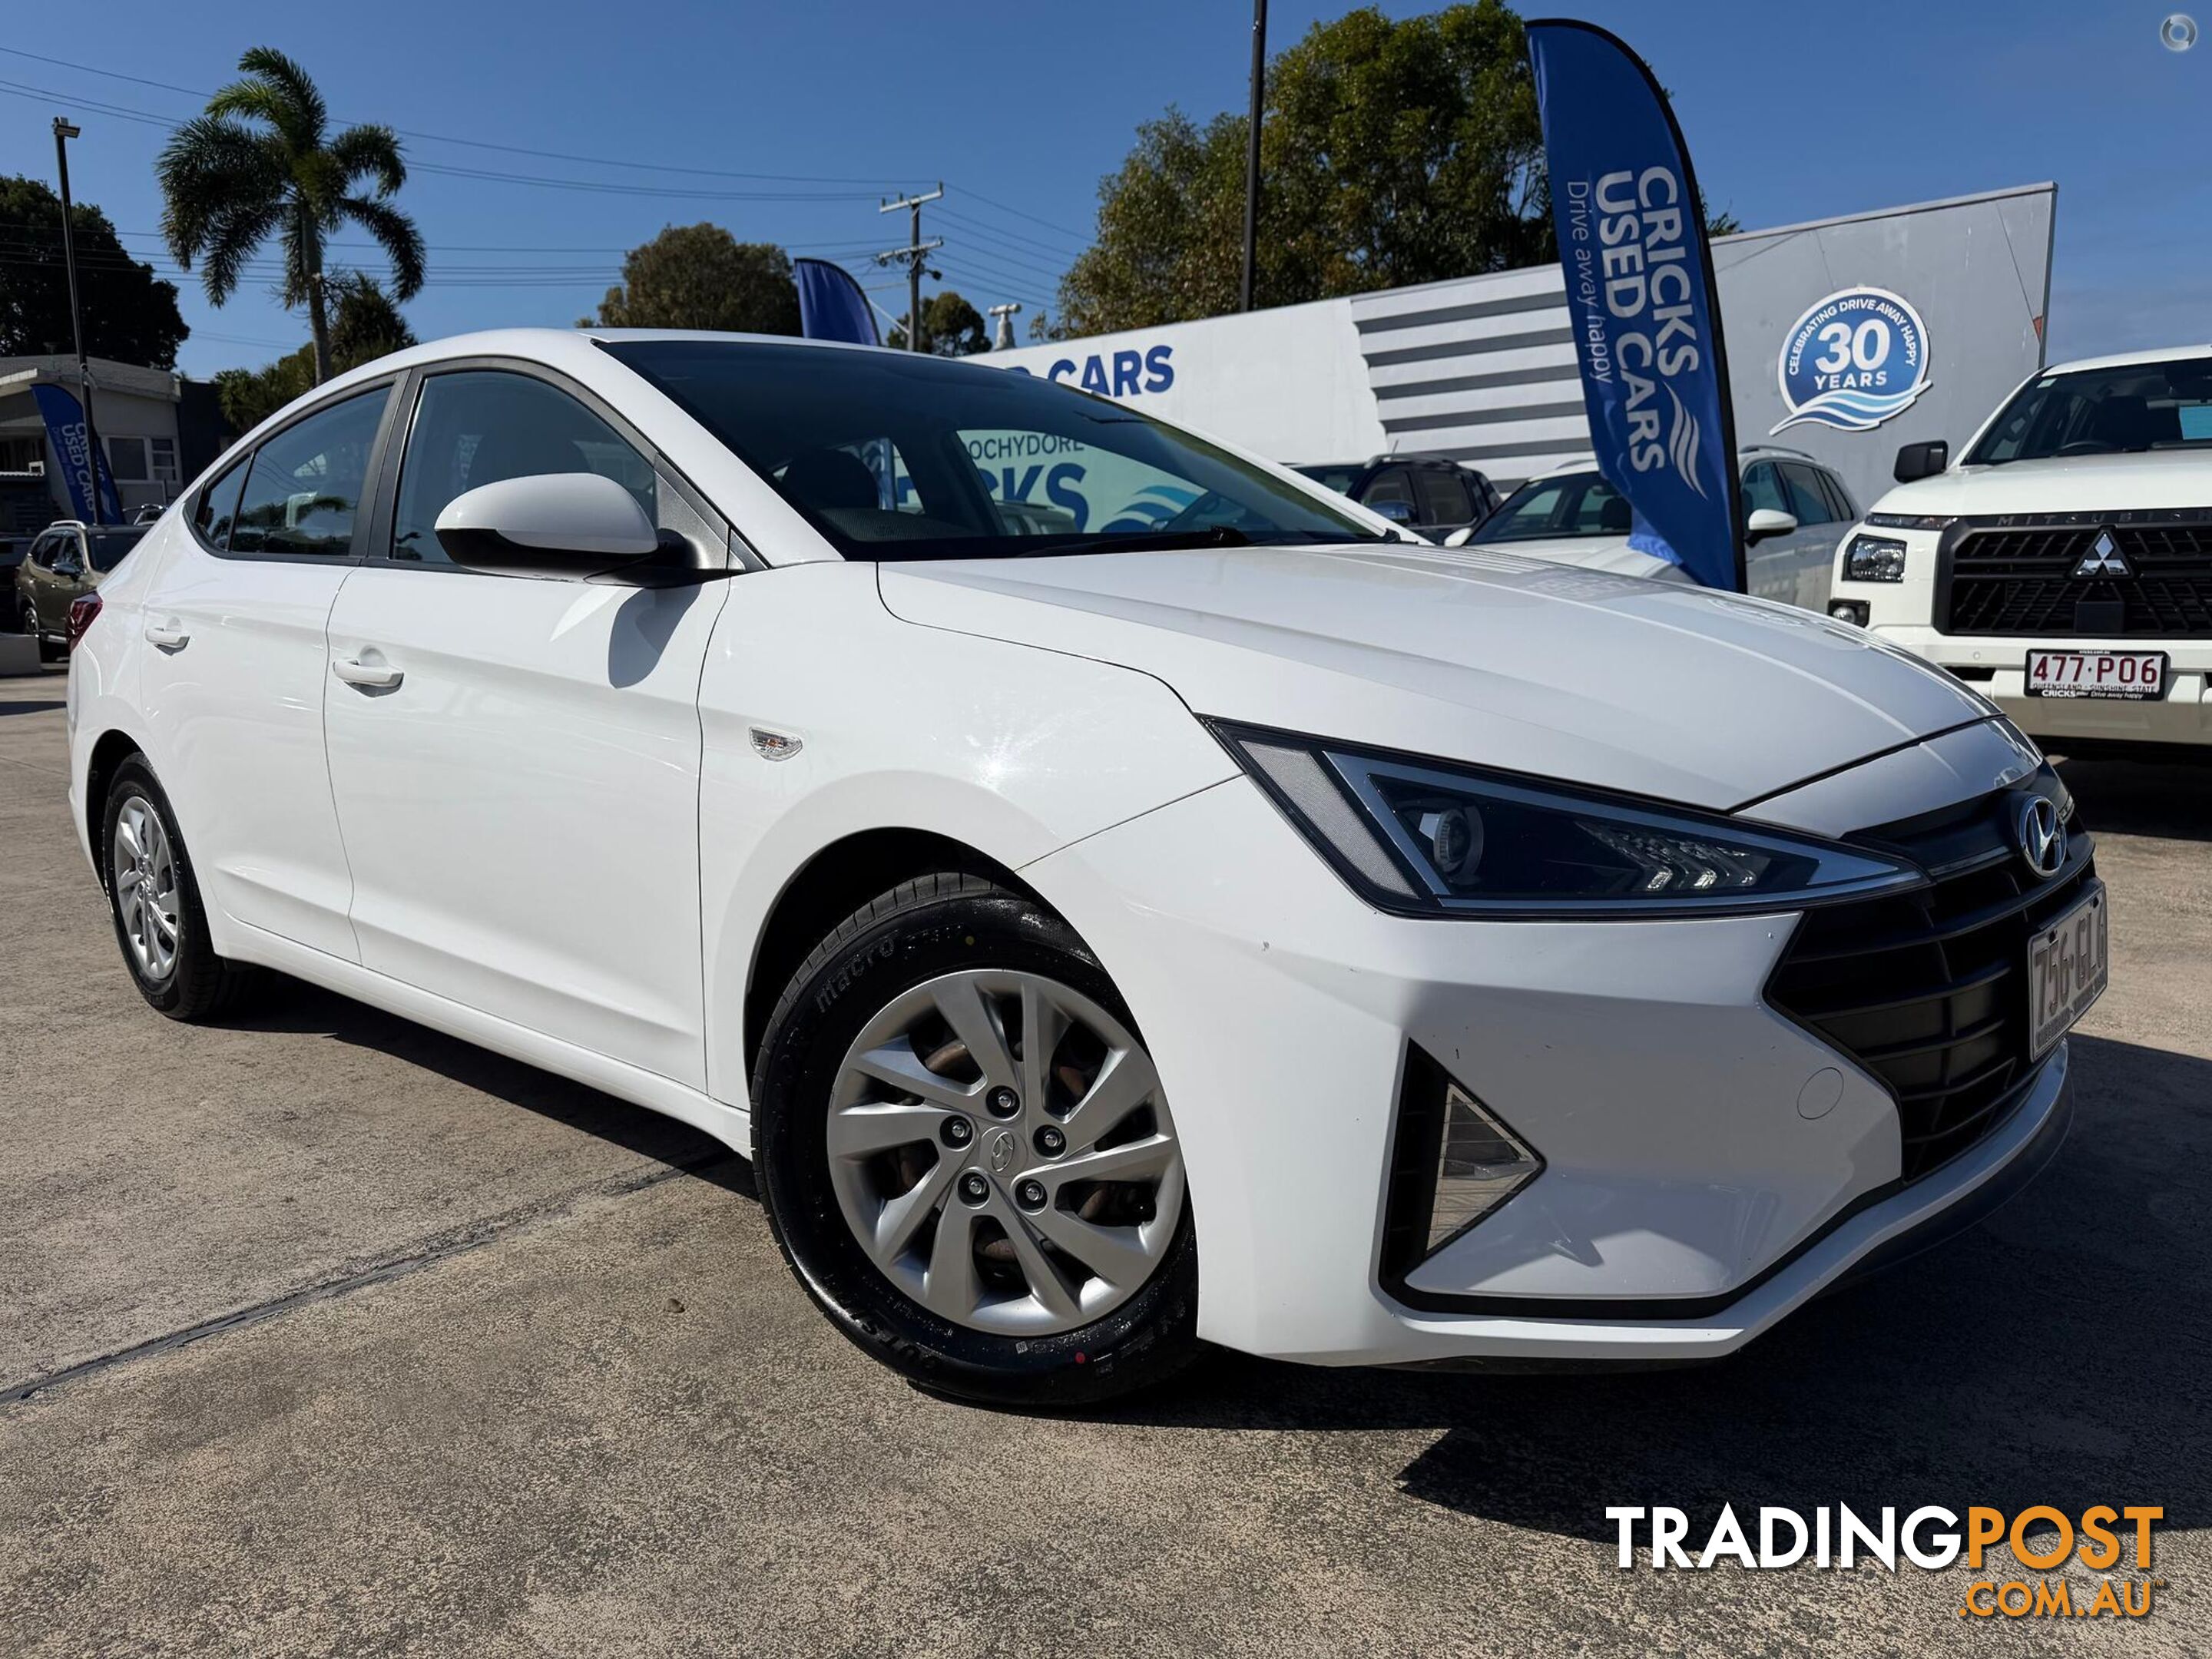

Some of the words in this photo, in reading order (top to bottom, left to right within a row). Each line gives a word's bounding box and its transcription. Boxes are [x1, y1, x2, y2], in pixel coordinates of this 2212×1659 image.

[1567, 181, 1592, 241] Drive
[1596, 170, 1646, 318] USED
[1639, 166, 1699, 376] CRICKS
[1575, 248, 1599, 313] away
[1587, 313, 1612, 384] happy
[1789, 306, 1838, 376] CELEBRATING
[1839, 299, 1876, 313] DRIVE
[1875, 303, 1906, 327] AWAY
[1900, 325, 1917, 367] HAPPY
[1815, 319, 1890, 374] 30
[1048, 345, 1174, 397] CARS
[1615, 332, 1664, 472] CARS
[1814, 371, 1887, 390] YEARS
[61, 424, 84, 466] USED
